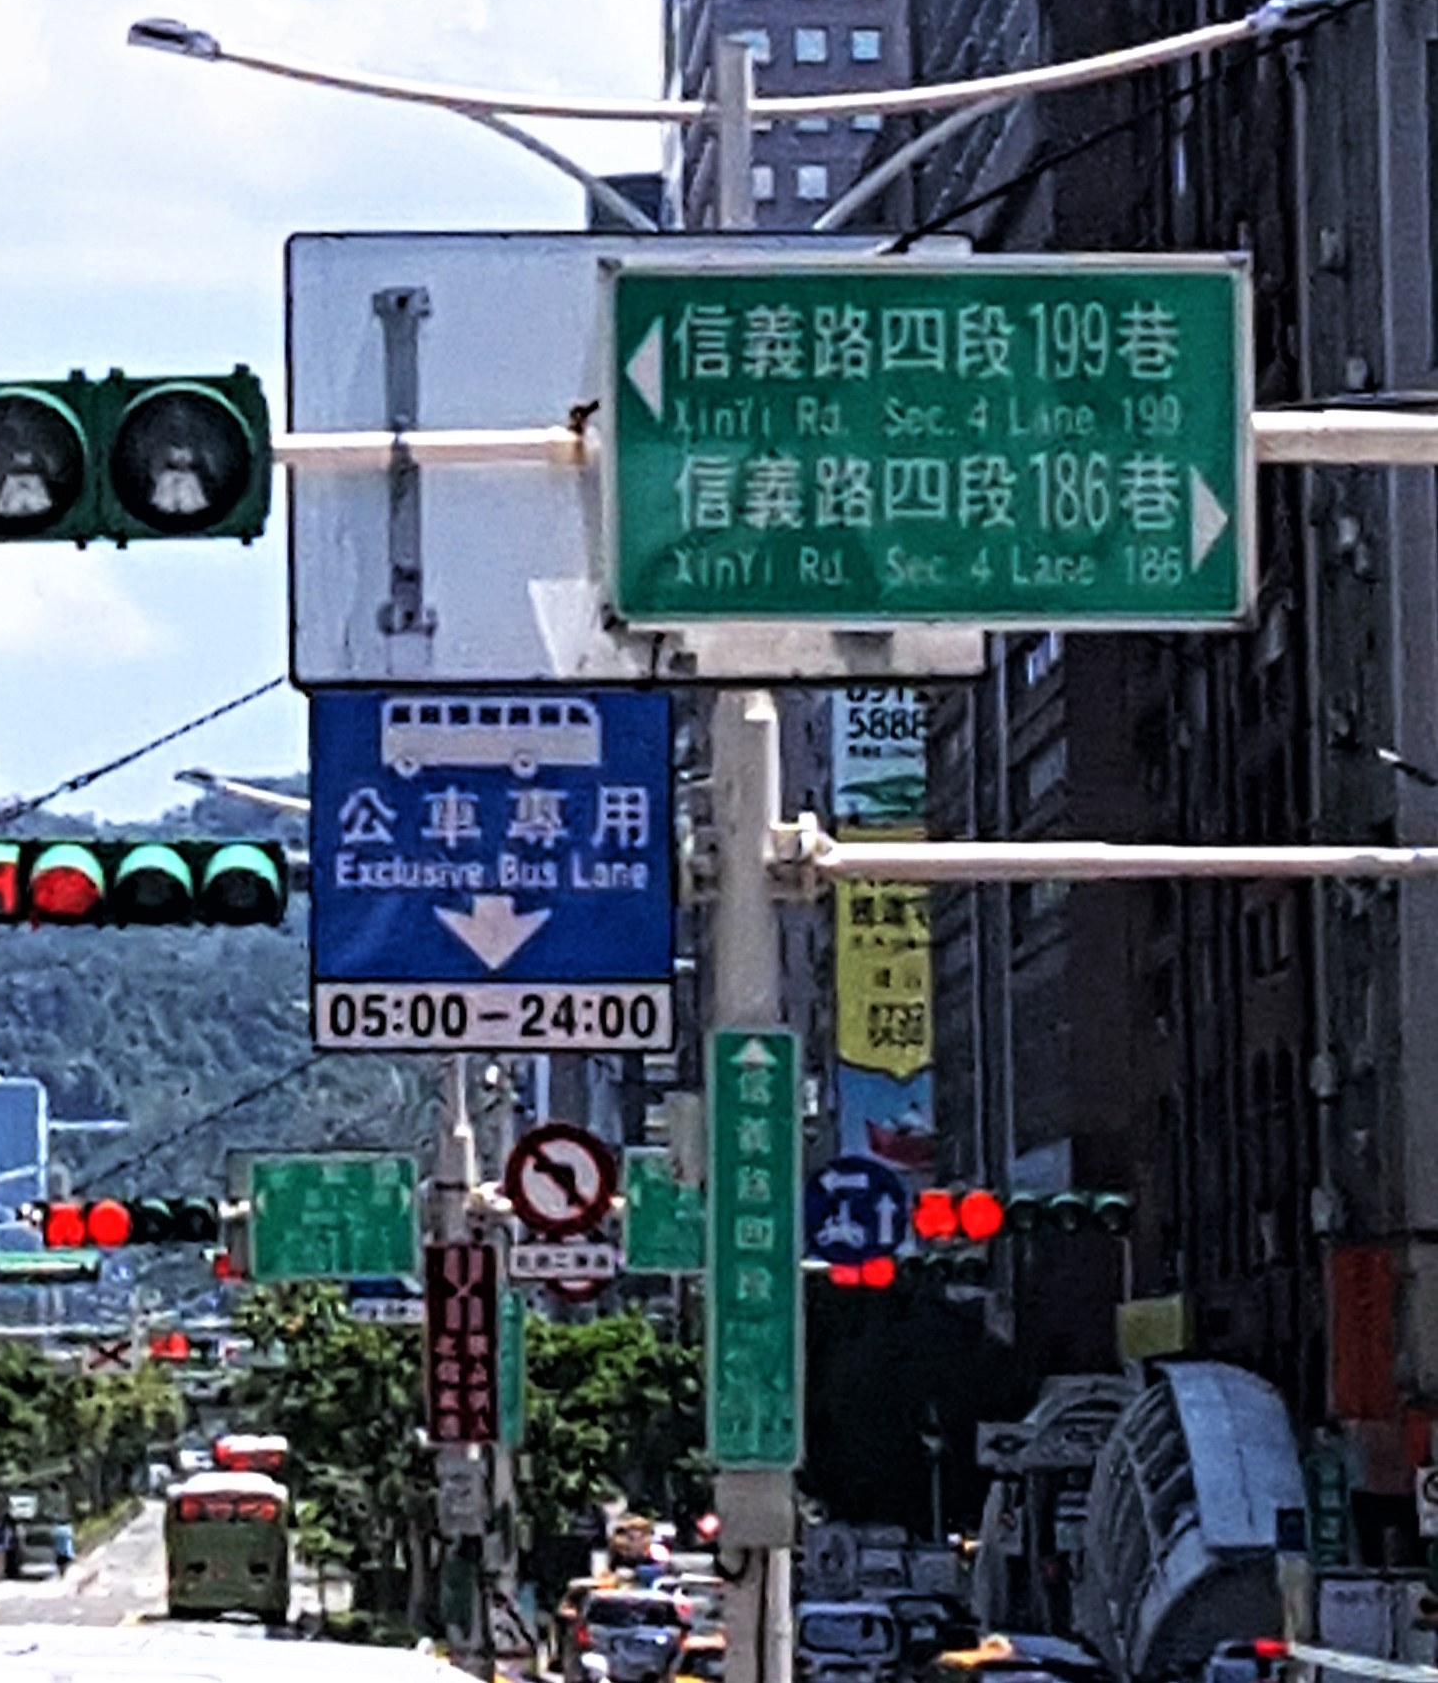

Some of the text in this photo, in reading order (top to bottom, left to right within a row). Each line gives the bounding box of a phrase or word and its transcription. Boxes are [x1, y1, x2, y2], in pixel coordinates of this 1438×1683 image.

[673, 303, 1181, 381] 信義路四段199巷
[968, 396, 987, 436] 4
[1009, 396, 1095, 436] Lane
[1121, 394, 1182, 436] 199
[674, 453, 1181, 531] 信義路四段186巷
[970, 546, 992, 585] 4
[1012, 544, 1096, 586] Lane
[1125, 545, 1183, 585] 186
[338, 785, 650, 850] 公車專用
[335, 850, 650, 890] Exclusive Bus Lane
